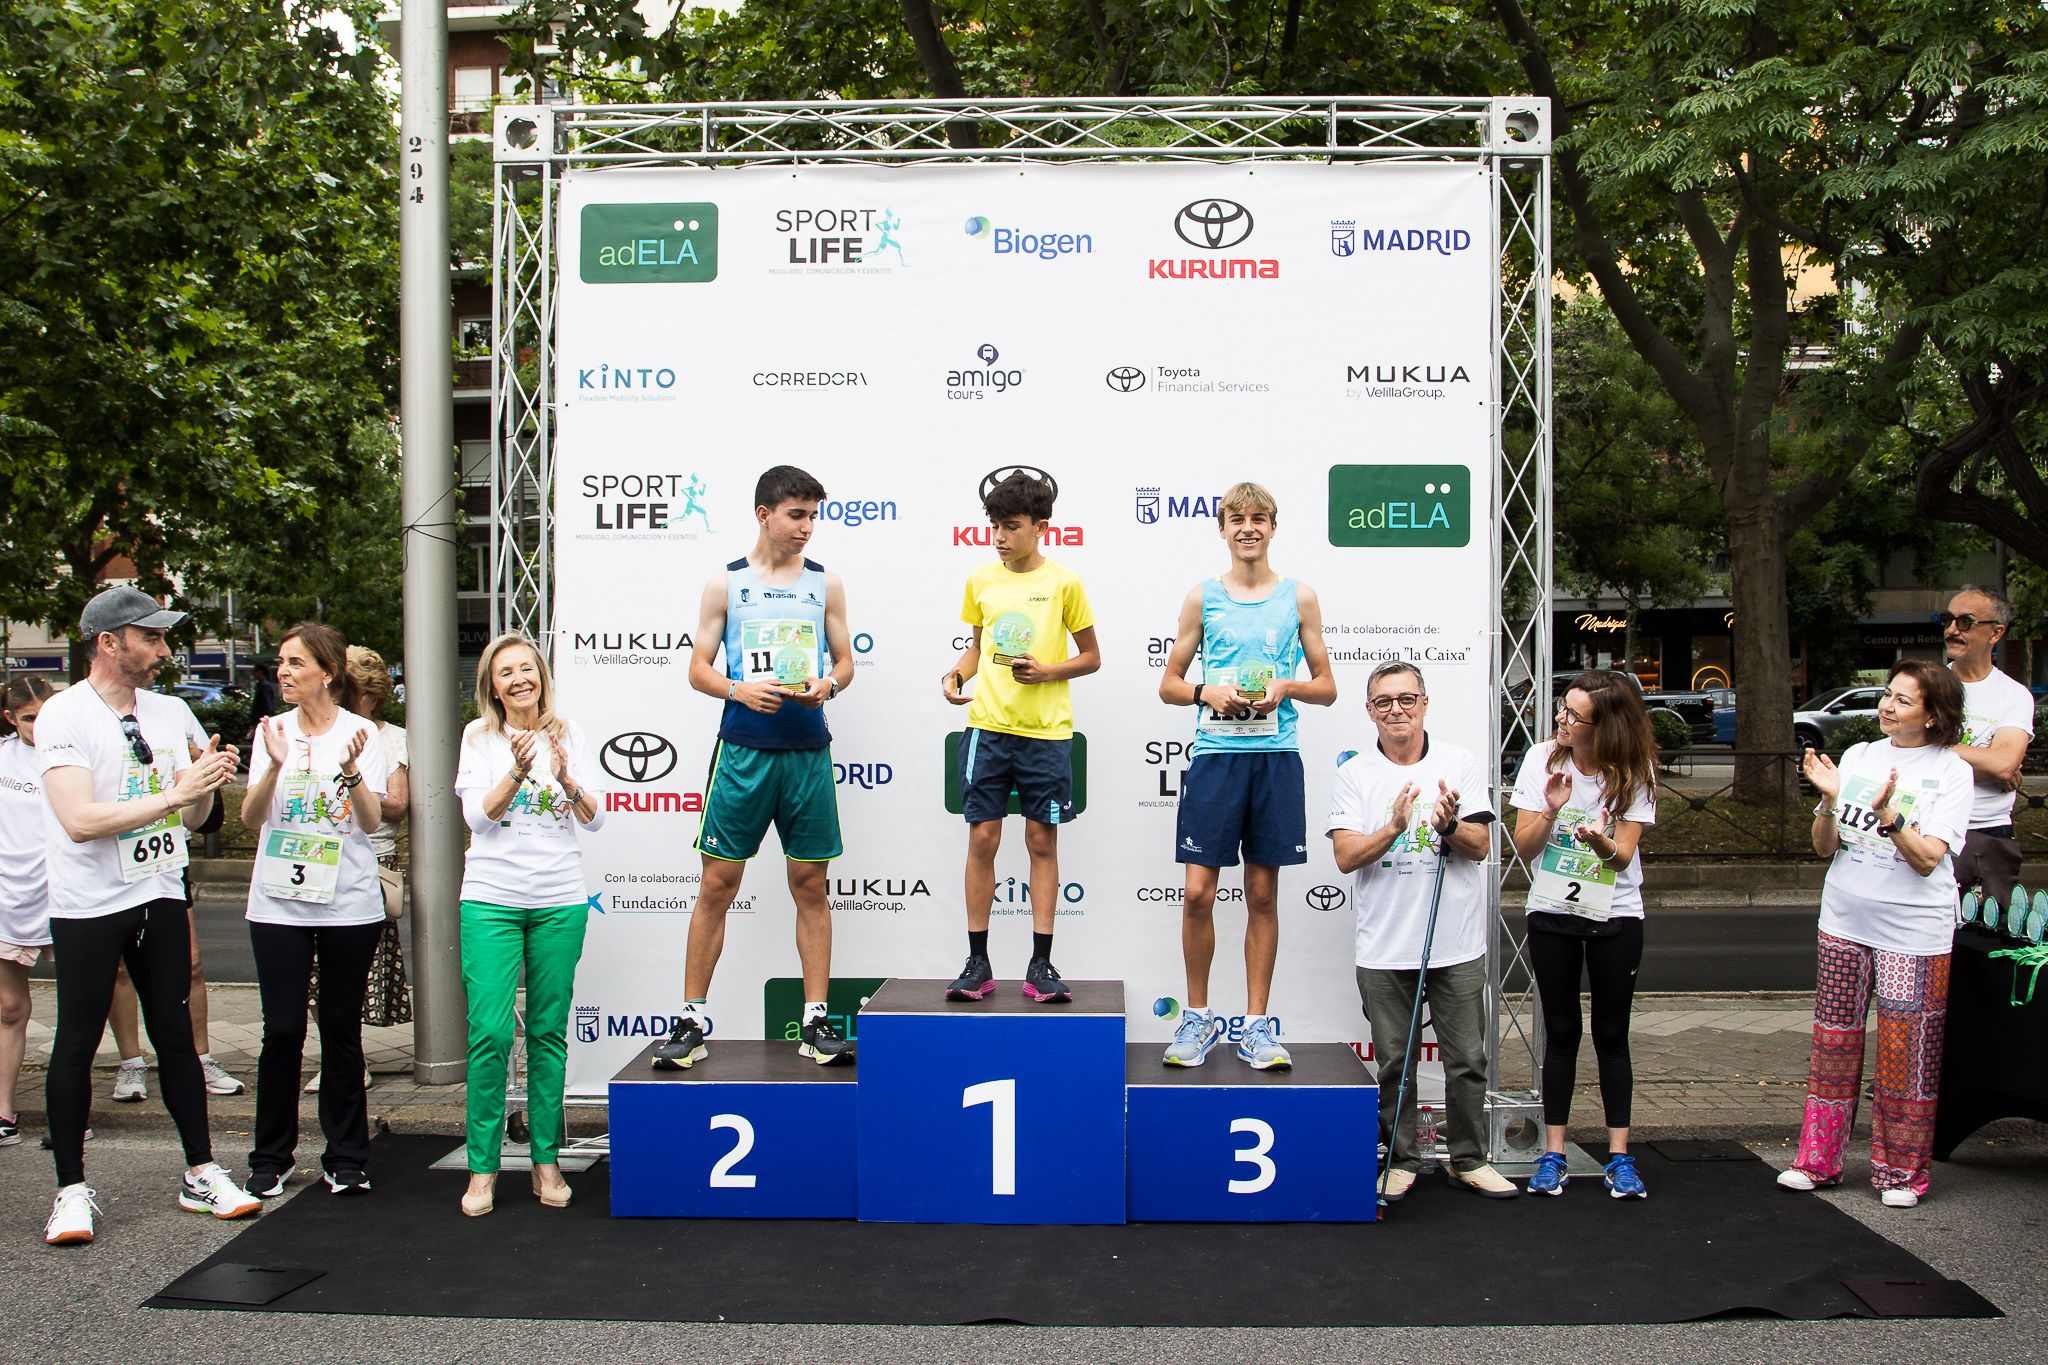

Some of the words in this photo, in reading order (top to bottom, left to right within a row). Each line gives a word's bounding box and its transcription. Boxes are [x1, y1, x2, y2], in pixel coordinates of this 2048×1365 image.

[775, 208, 877, 233] SPORT
[599, 239, 699, 266] adELA
[789, 237, 864, 264] LIFE
[993, 228, 1093, 260] Biogen
[1362, 229, 1471, 255] MADRID
[946, 370, 1022, 393] amigo
[1158, 366, 1201, 379] Toyota
[1347, 365, 1471, 383] MUKUA
[947, 389, 984, 400] tours
[1158, 381, 1214, 392] Financial
[1218, 381, 1270, 392] Services
[1346, 387, 1362, 400] by
[1365, 386, 1446, 400] VelillaGroup.
[579, 394, 608, 402] Flexible
[609, 394, 639, 403] Mobility
[640, 394, 676, 402] Solutions
[582, 474, 683, 498] SPORT
[596, 503, 669, 529] LIFE
[819, 499, 898, 527] iogen
[1348, 502, 1451, 529] adELA
[1321, 625, 1338, 634] on
[1341, 625, 1350, 634] la
[1353, 624, 1421, 634] colaboración
[1423, 624, 1440, 634] de:
[1863, 634, 1900, 645] Centro
[1901, 634, 1915, 644] de
[575, 633, 694, 650] MUKUA
[574, 654, 590, 667] by
[593, 653, 671, 667] VelillaGroup.
[833, 763, 893, 790] DRID
[133, 832, 175, 863] 698
[290, 863, 306, 886] 3
[604, 873, 626, 883] Con
[628, 873, 638, 883] la
[640, 873, 701, 883] colaboració
[826, 879, 931, 896] UKUA
[1564, 881, 1582, 903] 2
[612, 895, 688, 909] Fundación
[1054, 908, 1085, 916] olutions
[962, 1079, 1016, 1196] 1
[708, 1113, 758, 1189] 2
[1227, 1117, 1278, 1195] 3
